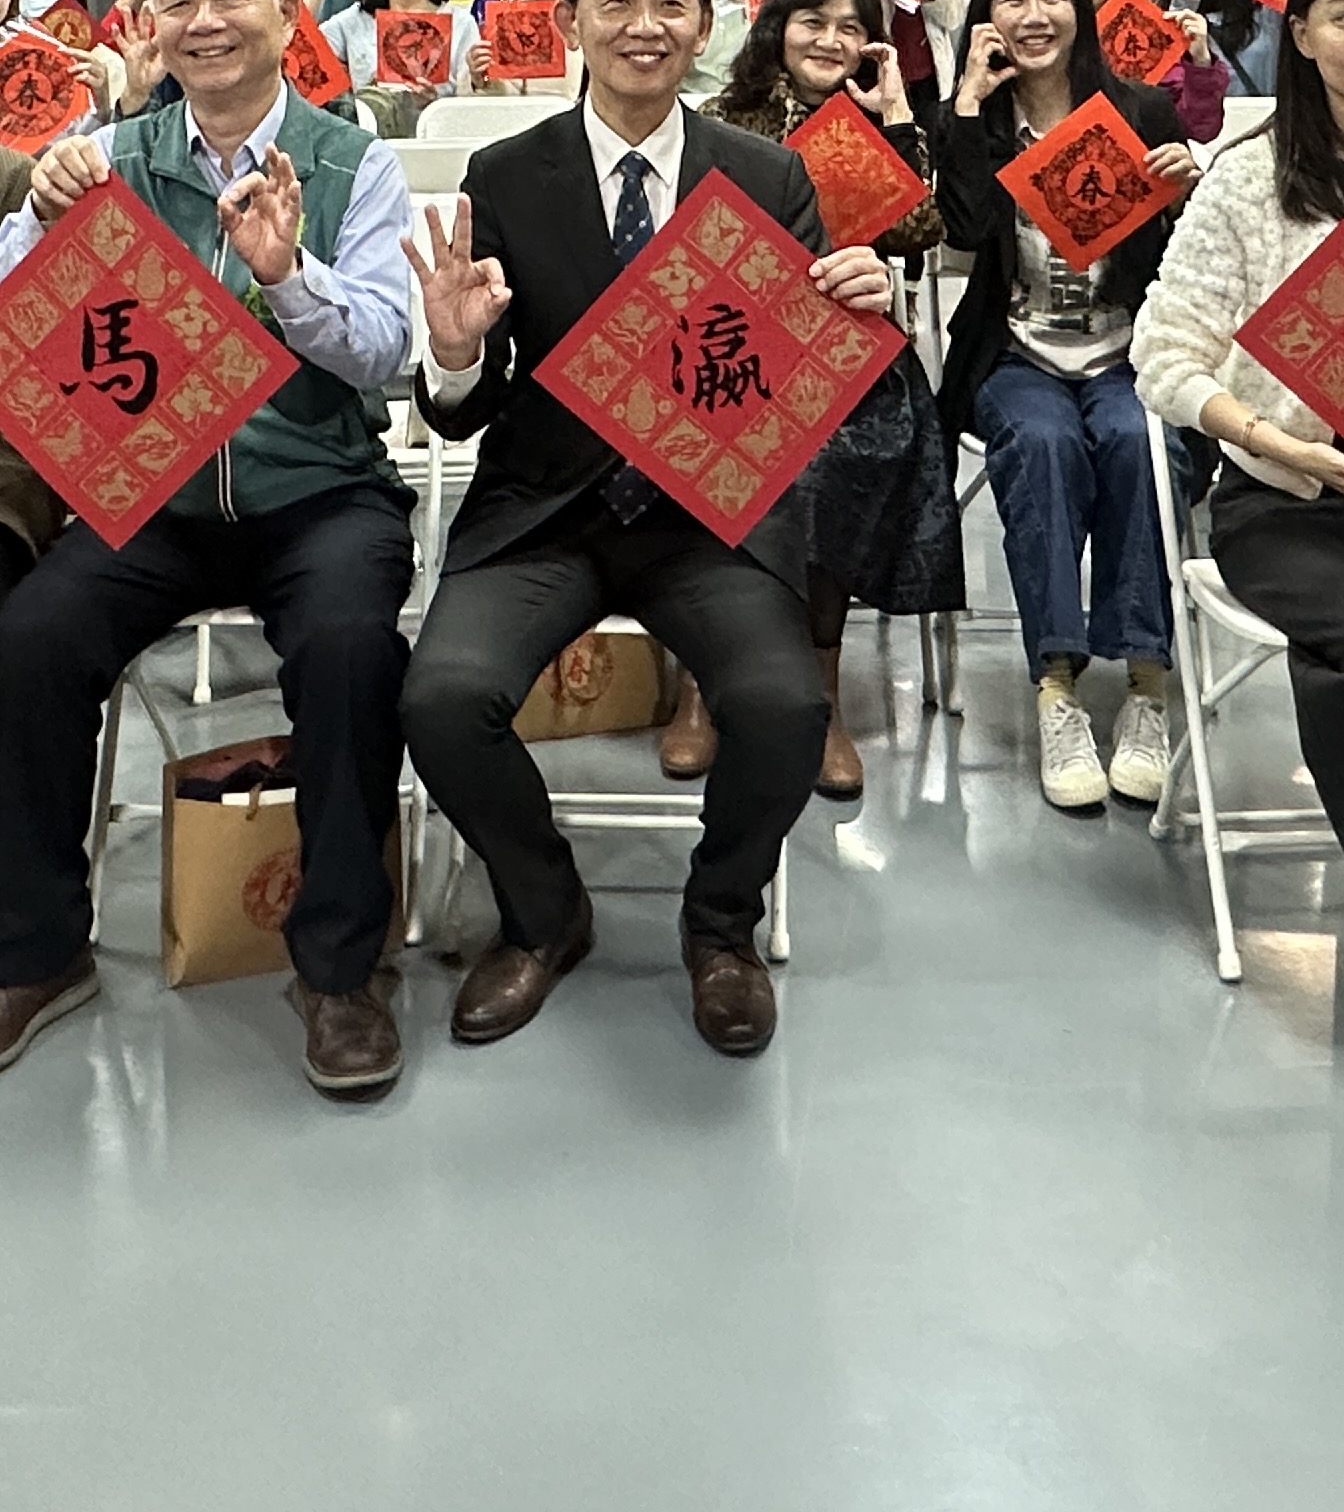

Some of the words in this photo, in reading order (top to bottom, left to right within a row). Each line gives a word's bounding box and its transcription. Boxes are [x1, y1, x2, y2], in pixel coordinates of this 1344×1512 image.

[1122, 31, 1148, 58] 春
[10, 72, 47, 110] 春
[1071, 164, 1112, 206] 春
[59, 298, 160, 416] 馬
